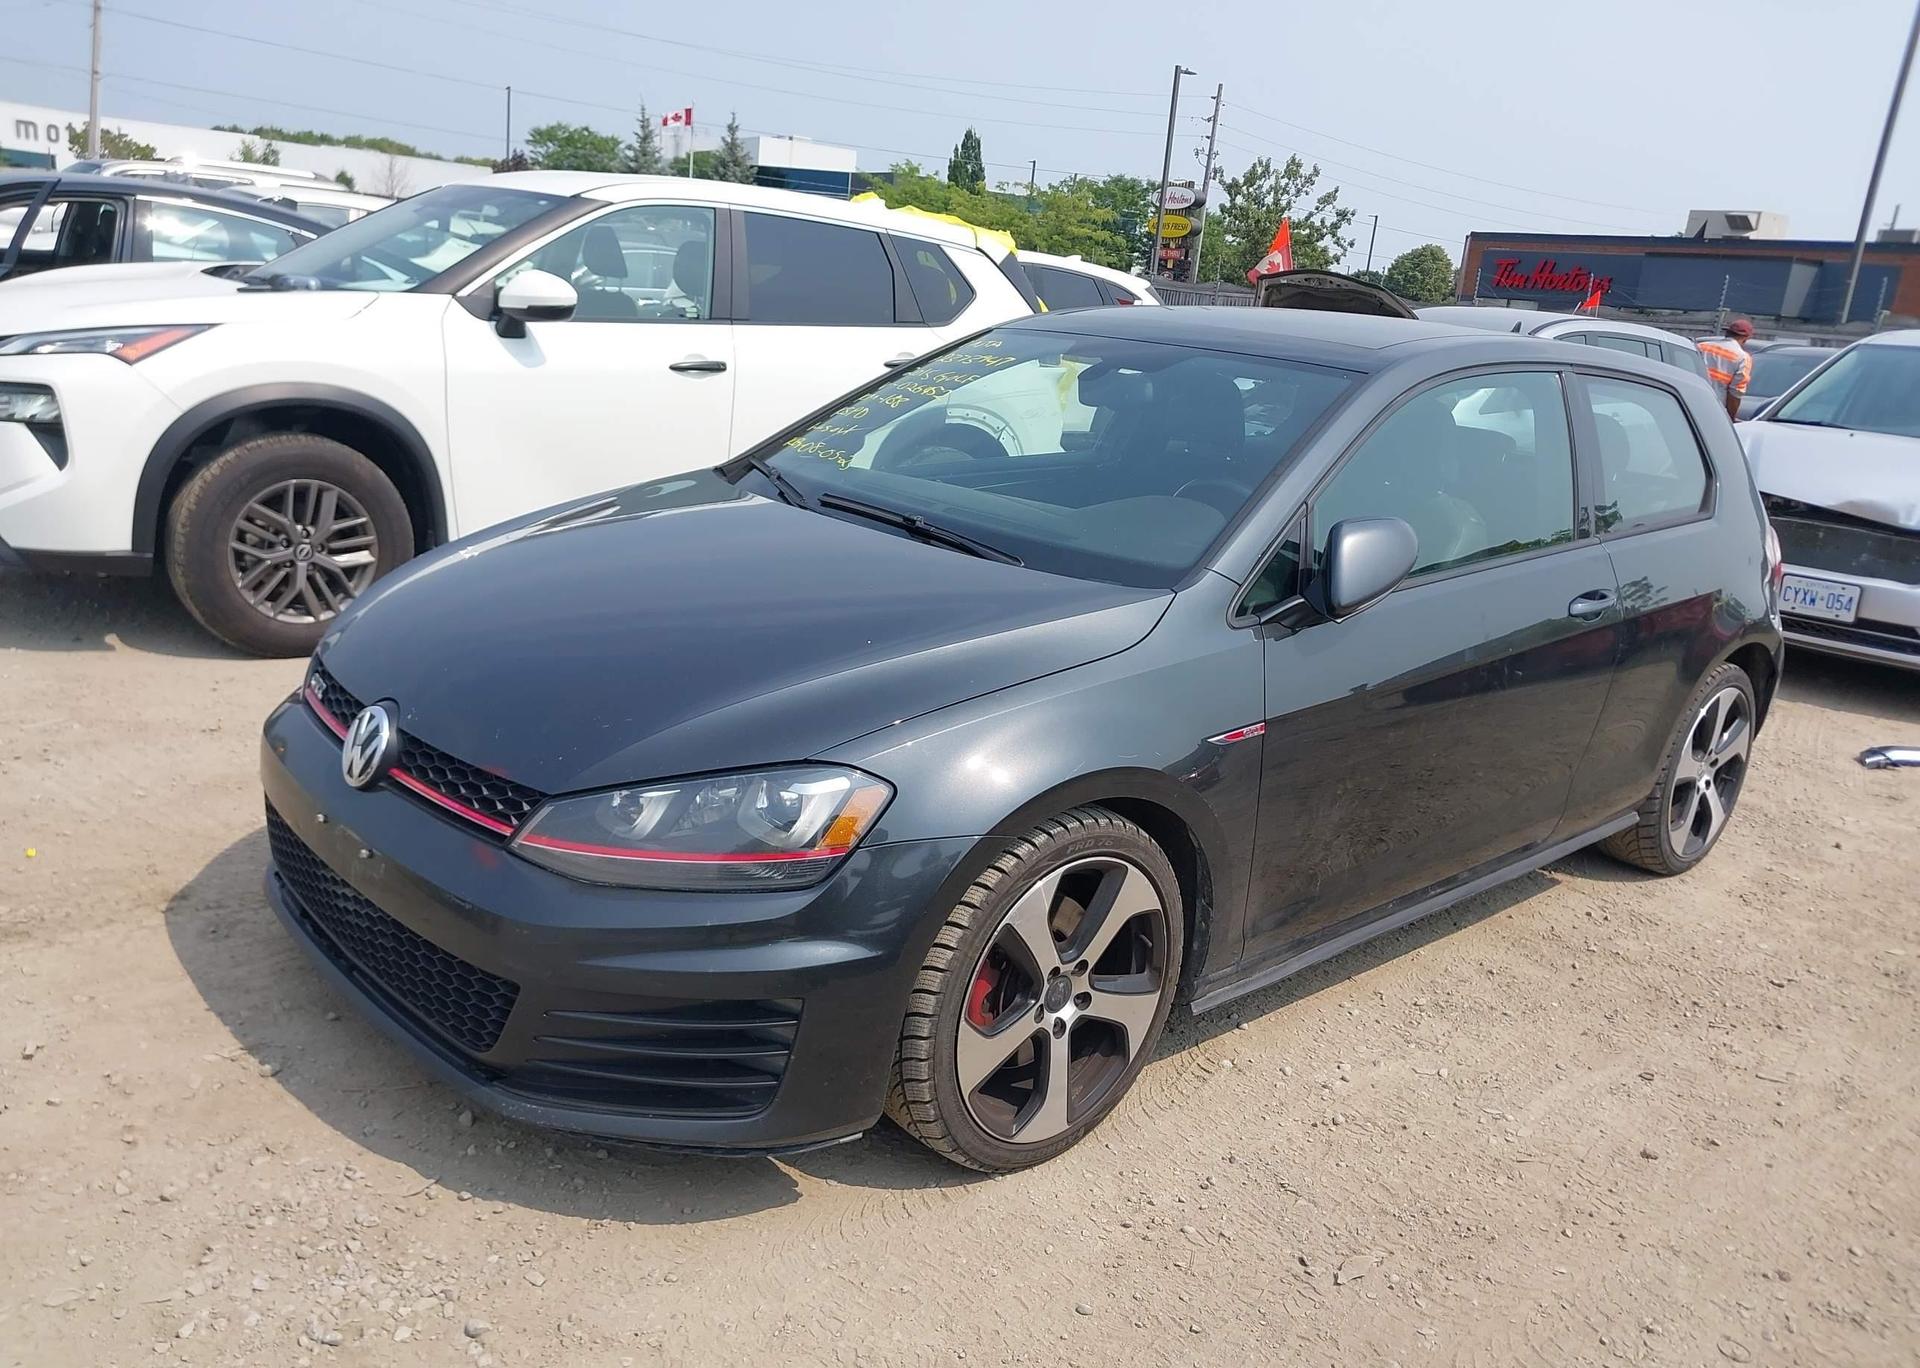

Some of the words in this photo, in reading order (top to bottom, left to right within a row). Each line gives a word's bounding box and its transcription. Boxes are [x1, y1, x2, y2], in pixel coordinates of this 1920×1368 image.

[1492, 258, 1529, 288] Tim
[1783, 585, 1818, 607] CYXW
[1826, 592, 1853, 613] 054
